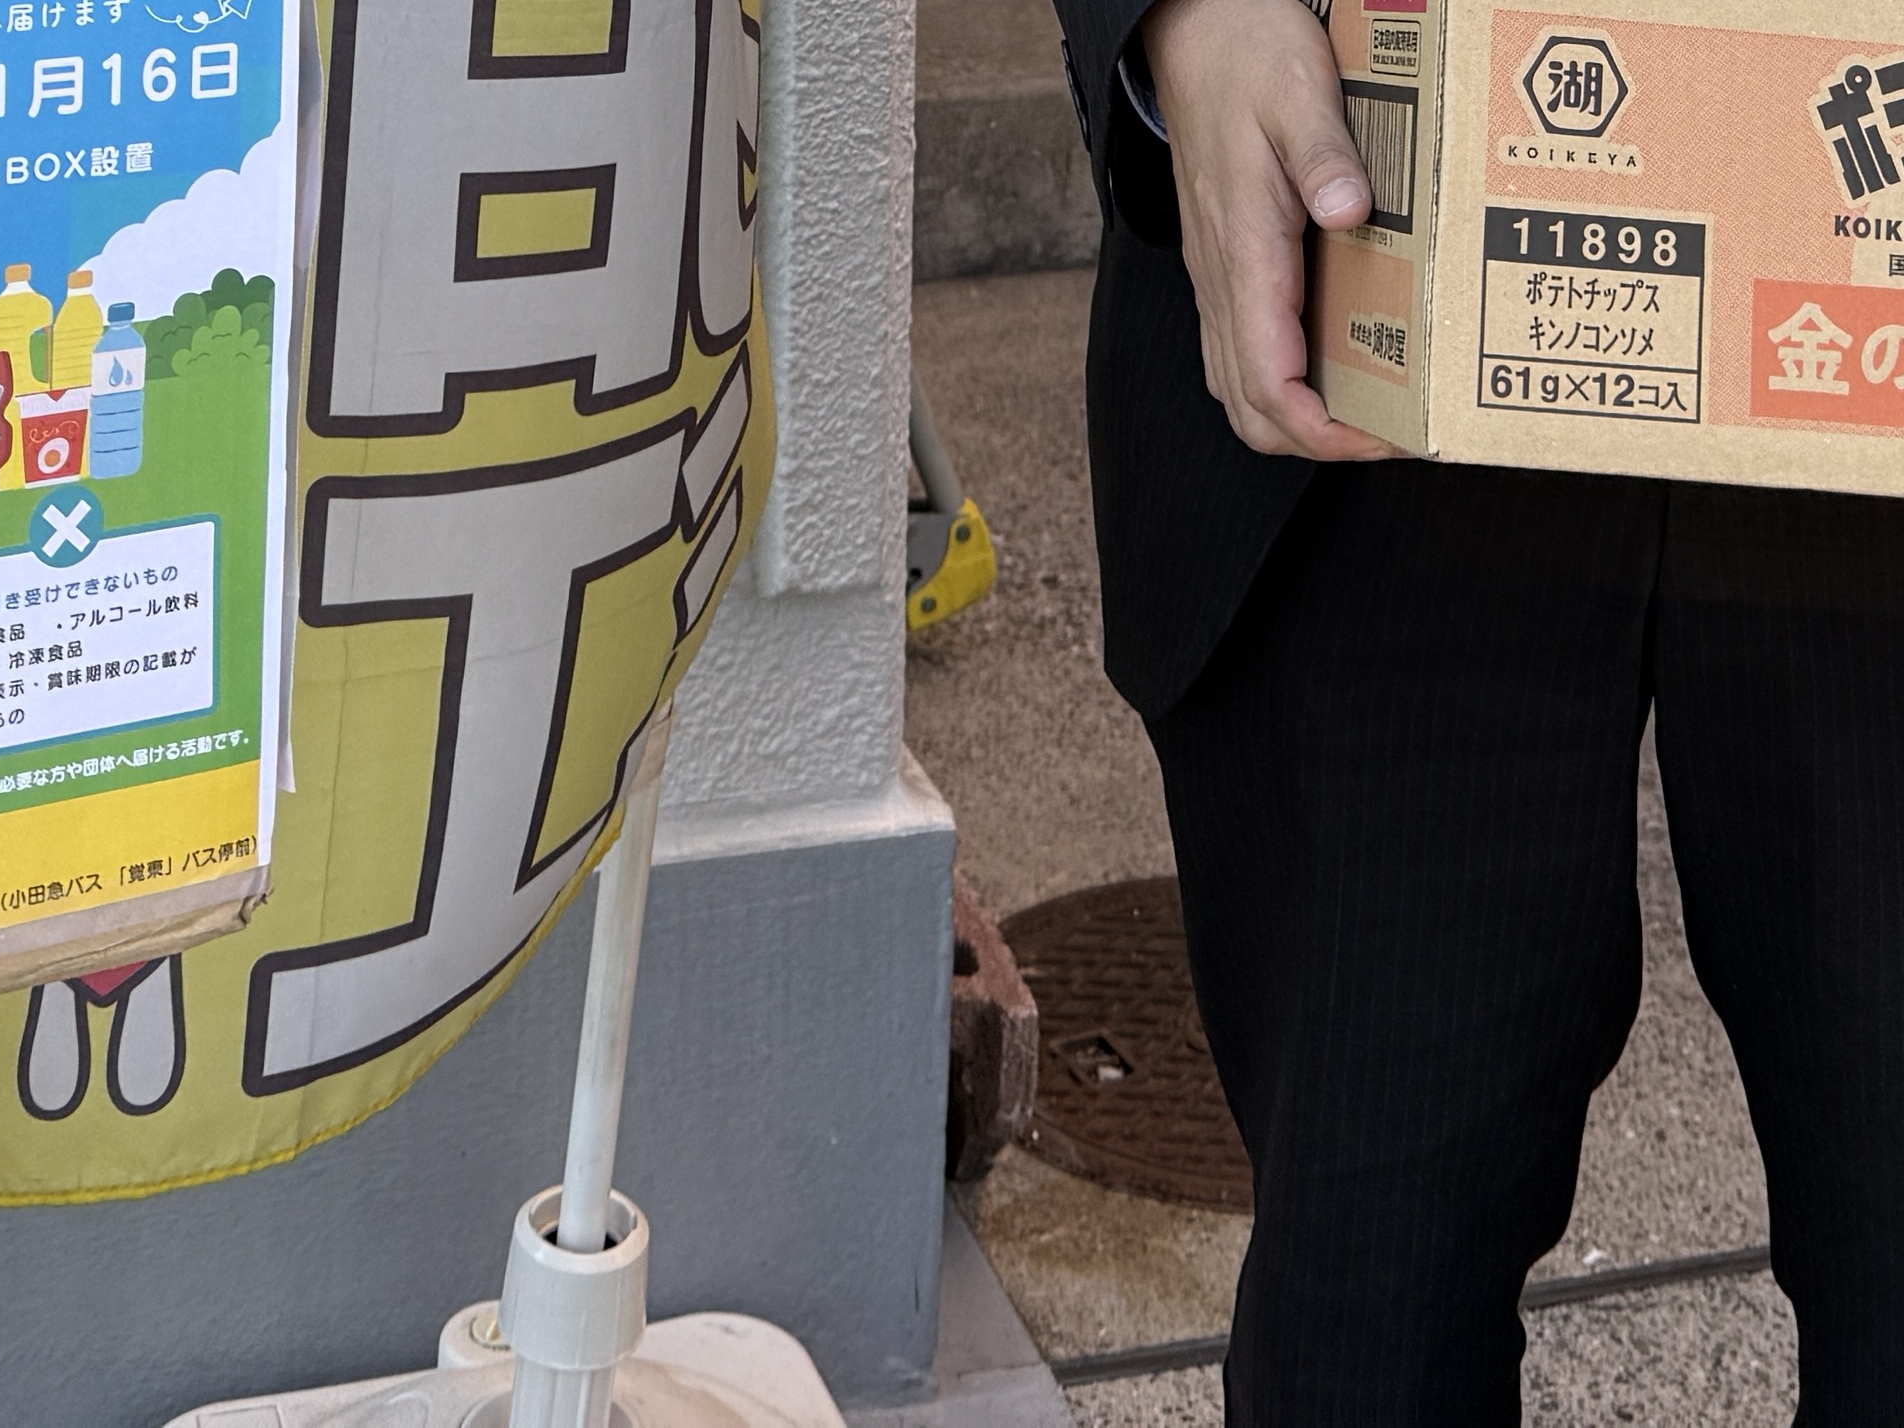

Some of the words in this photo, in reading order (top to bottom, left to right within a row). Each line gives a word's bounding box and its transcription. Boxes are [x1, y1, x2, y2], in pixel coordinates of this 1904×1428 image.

[1547, 60, 1603, 117] 湖
[1507, 143, 1638, 169] KOIKEYA
[1512, 217, 1680, 267] 11898
[1525, 271, 1661, 314] ポテトチップス
[1529, 316, 1655, 358] キンノコンソメ
[1490, 363, 1687, 413] 61g×12コ入
